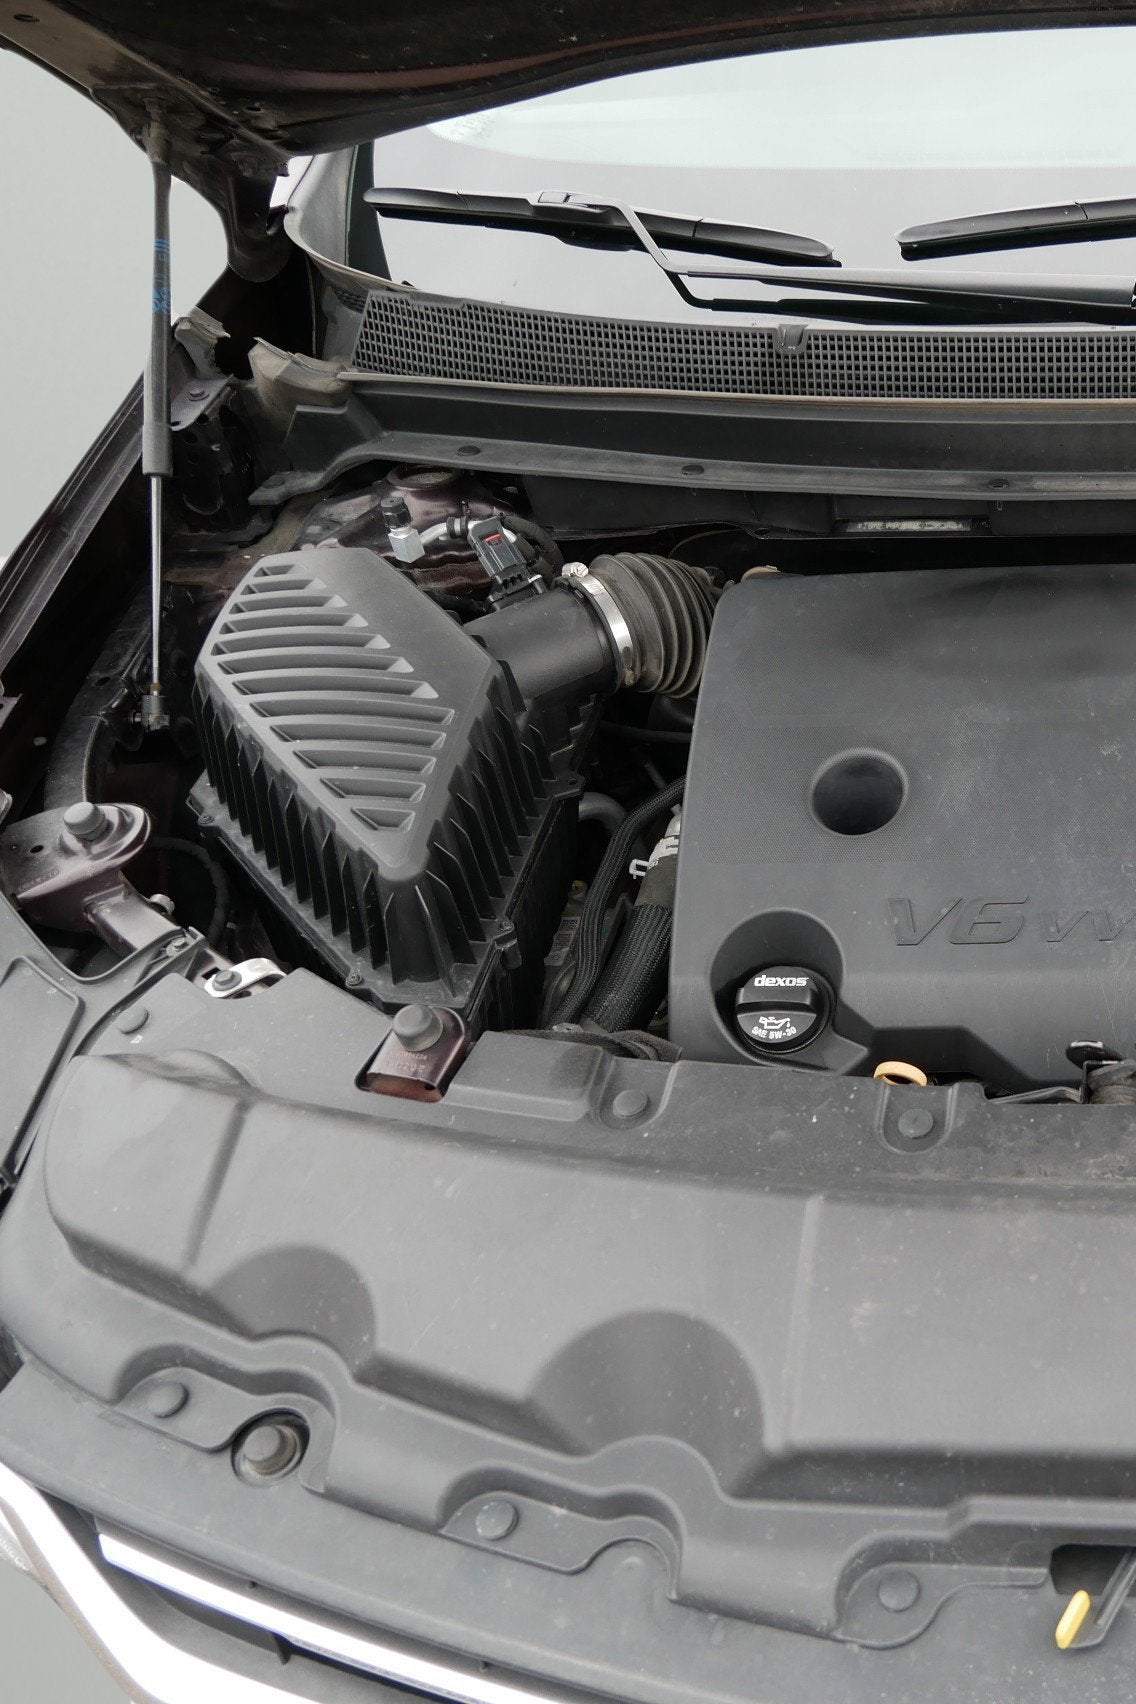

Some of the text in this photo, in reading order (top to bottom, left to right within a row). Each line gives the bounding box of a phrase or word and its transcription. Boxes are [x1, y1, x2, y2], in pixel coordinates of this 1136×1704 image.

[888, 895, 1030, 946] V6
[753, 974, 809, 987] dexos
[751, 1025, 798, 1040] SAE 5W-30
